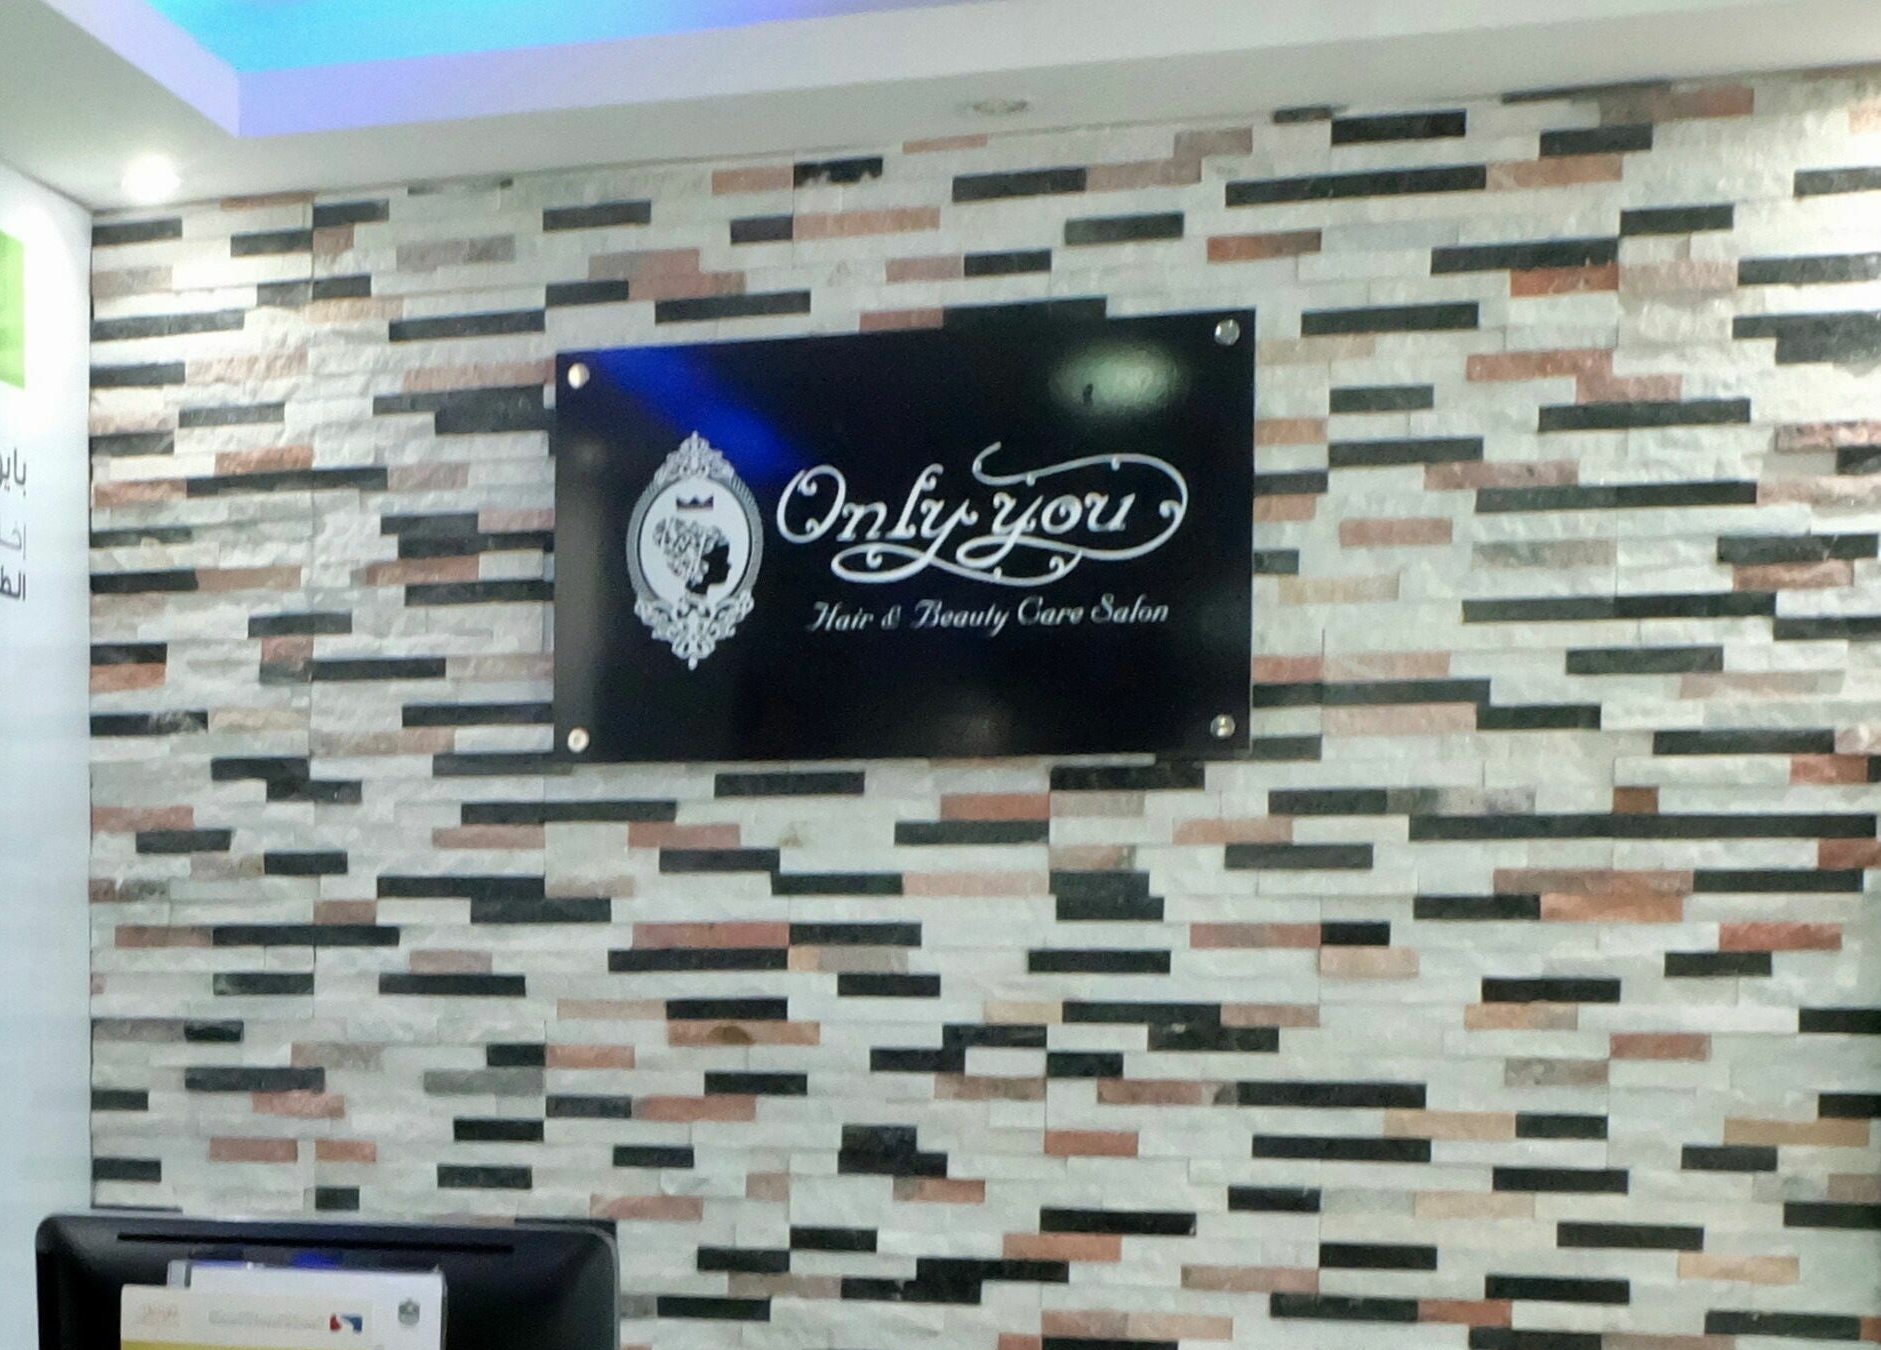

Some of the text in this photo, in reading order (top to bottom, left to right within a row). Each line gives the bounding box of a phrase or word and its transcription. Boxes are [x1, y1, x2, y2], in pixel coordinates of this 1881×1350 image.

[776, 463, 976, 584] Only
[806, 602, 874, 636] Hair
[911, 602, 1010, 637] Beauty
[1017, 599, 1085, 628] Care
[1090, 593, 1170, 625] Salon
